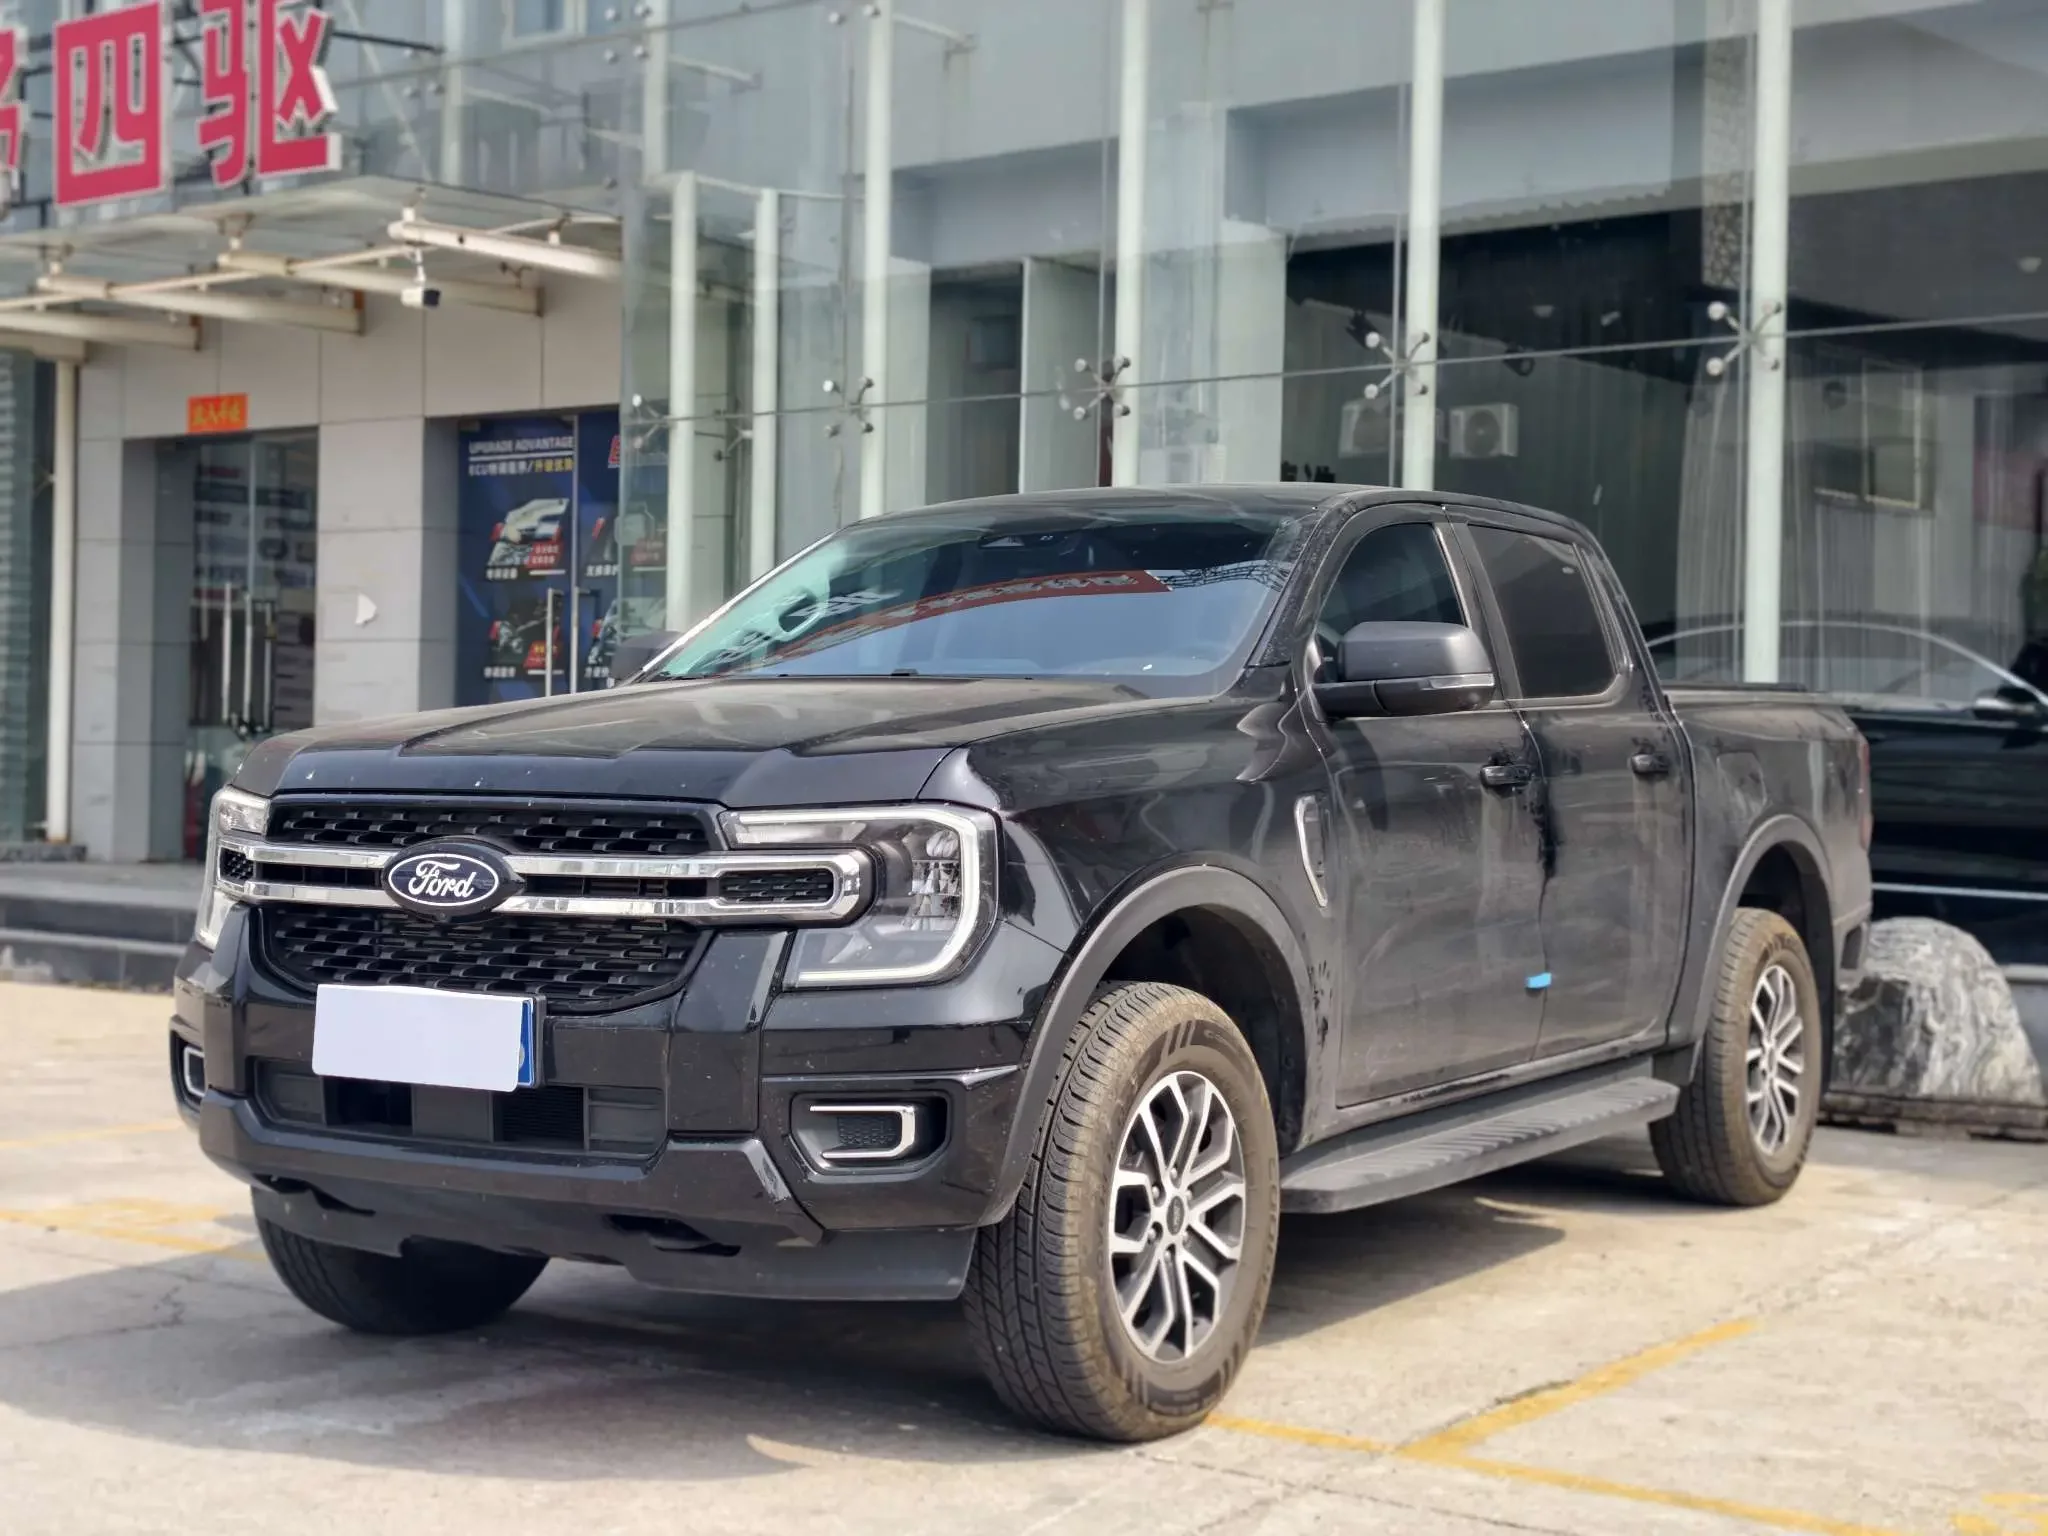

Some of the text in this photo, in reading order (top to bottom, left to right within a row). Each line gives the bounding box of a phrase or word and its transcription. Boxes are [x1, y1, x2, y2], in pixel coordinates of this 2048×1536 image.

[0, 0, 340, 206] 四驱
[515, 436, 575, 451] ADVANTAGE
[408, 860, 477, 898] Ford
